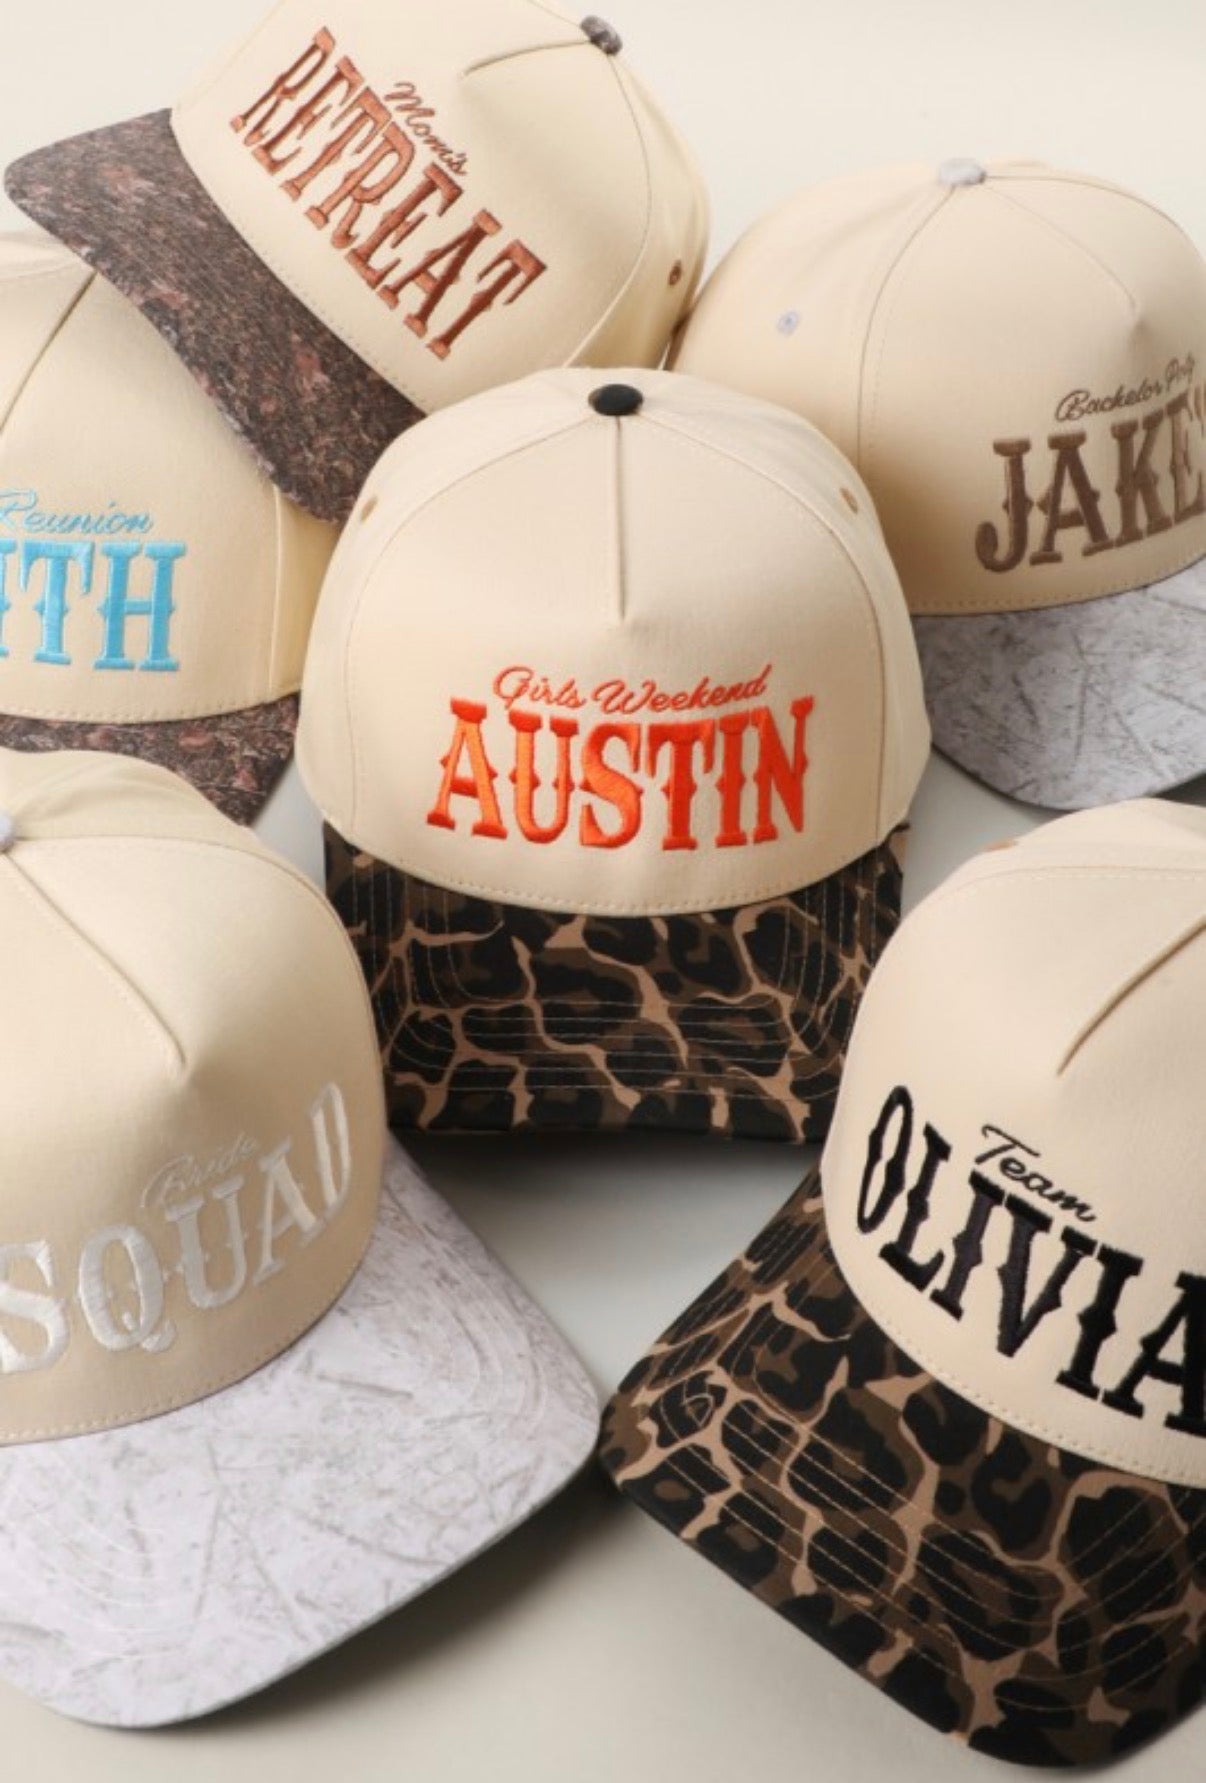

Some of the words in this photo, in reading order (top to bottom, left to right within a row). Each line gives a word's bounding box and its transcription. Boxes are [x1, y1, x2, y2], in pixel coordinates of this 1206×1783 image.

[383, 81, 468, 175] Mom's
[229, 26, 548, 361] RETREAT
[1054, 377, 1162, 422] Bachelor
[492, 665, 587, 710] Girls
[590, 663, 773, 715] Weekend
[426, 695, 815, 852] AUSTIN
[139, 1131, 259, 1208] Bride
[974, 1122, 1097, 1224] Team
[0, 1082, 352, 1375] SQUAD
[857, 1085, 1206, 1439] OLIVIA
